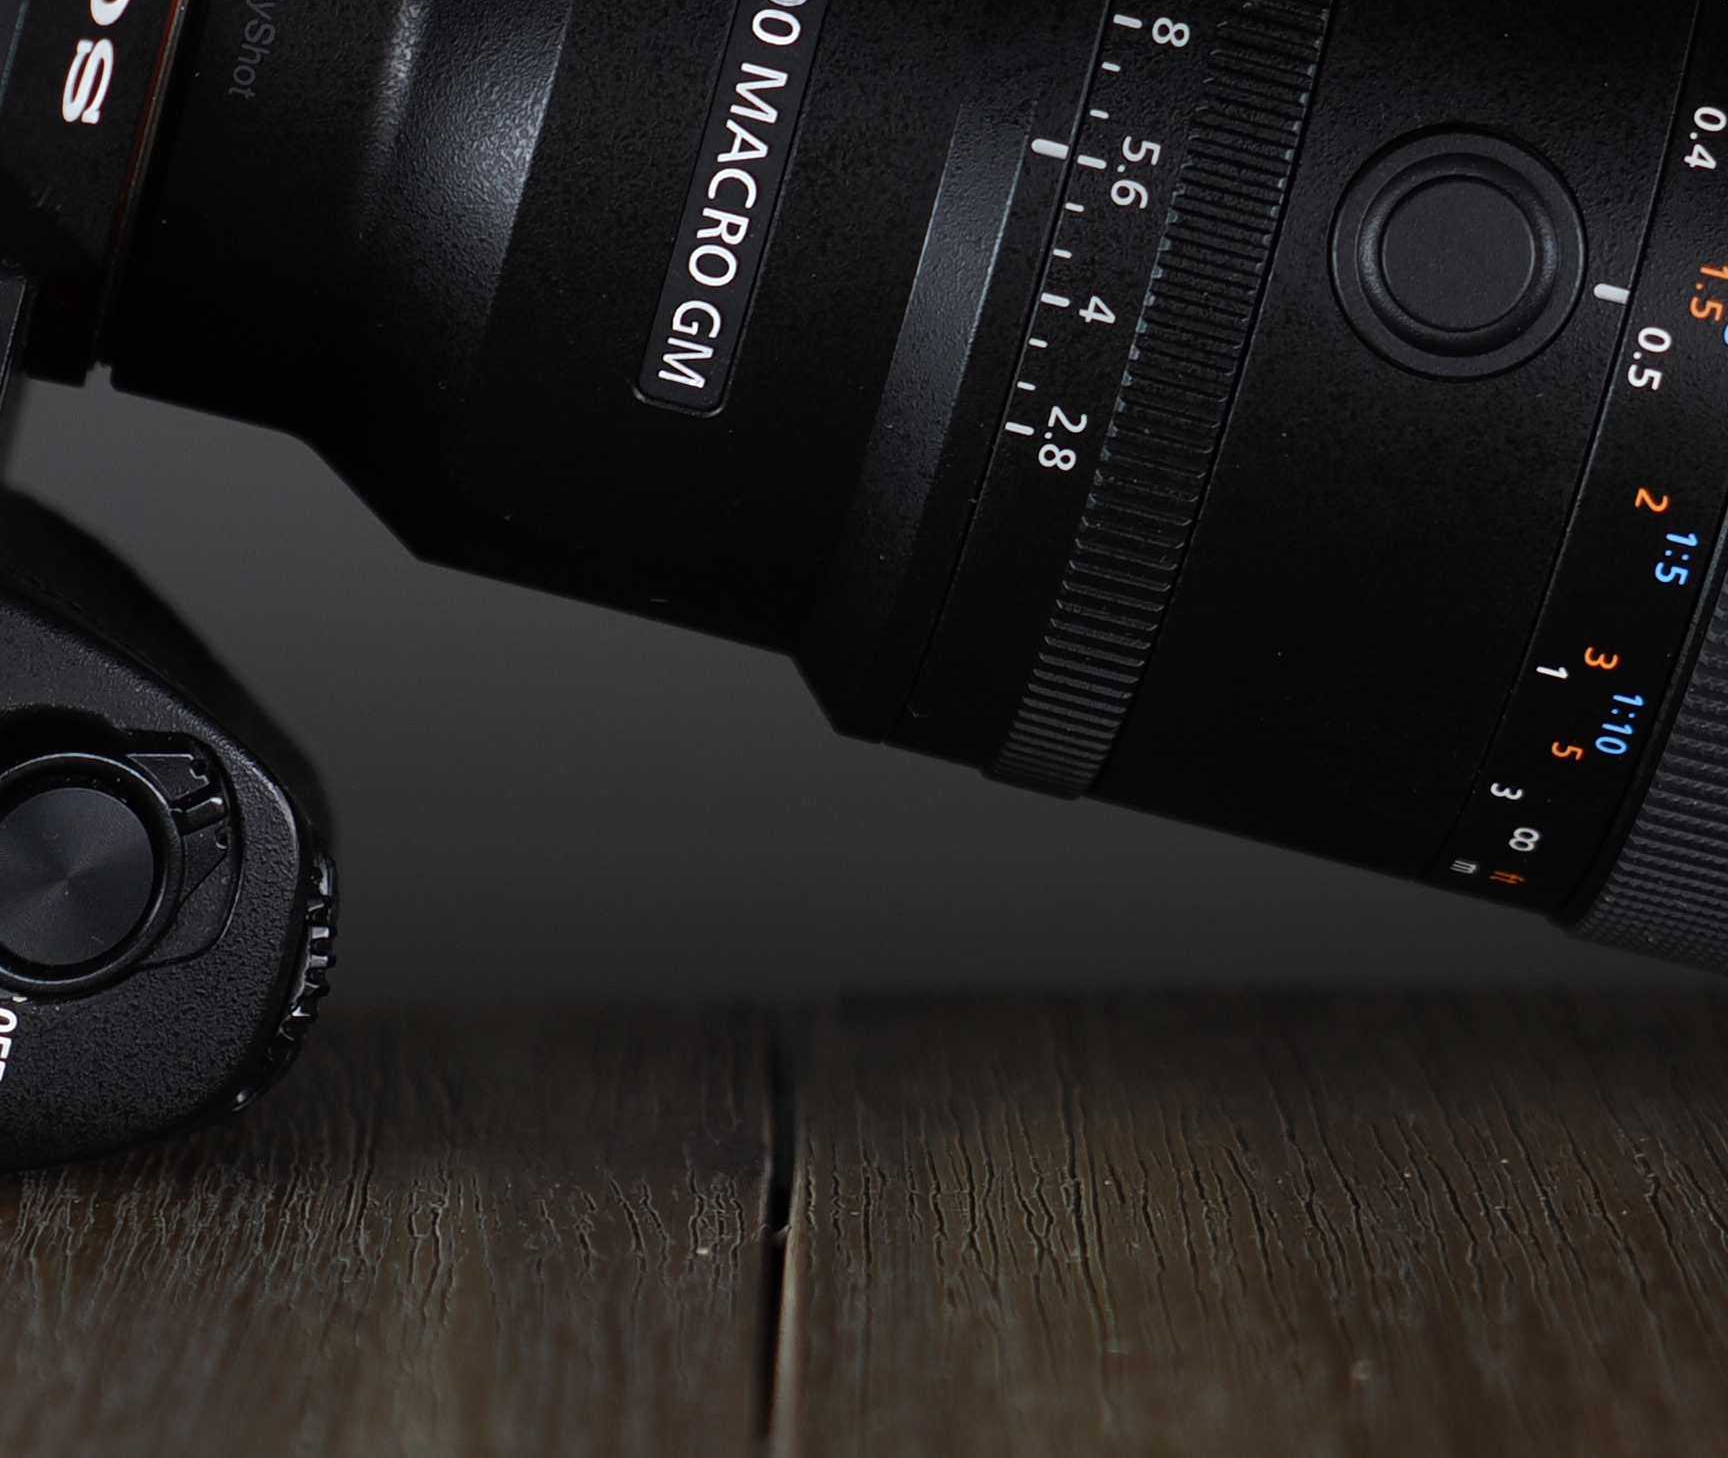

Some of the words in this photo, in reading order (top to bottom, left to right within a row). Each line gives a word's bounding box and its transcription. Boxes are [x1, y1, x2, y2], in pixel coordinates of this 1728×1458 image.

[1151, 16, 1191, 48] 8
[1683, 106, 1727, 170] 0.4
[688, 62, 789, 287] MACRO
[1108, 135, 1162, 209] 5.6
[1078, 295, 1116, 324] 4
[658, 300, 722, 389] GM
[1627, 326, 1672, 391] 0.5
[1038, 405, 1088, 471] 2.8
[1634, 487, 1669, 513] 2
[1654, 532, 1699, 586] 1:5
[1536, 666, 1569, 680] 1
[1583, 646, 1619, 670] 3
[1551, 741, 1584, 761] 5
[1594, 694, 1645, 755] 1:10
[1490, 782, 1523, 801] 3
